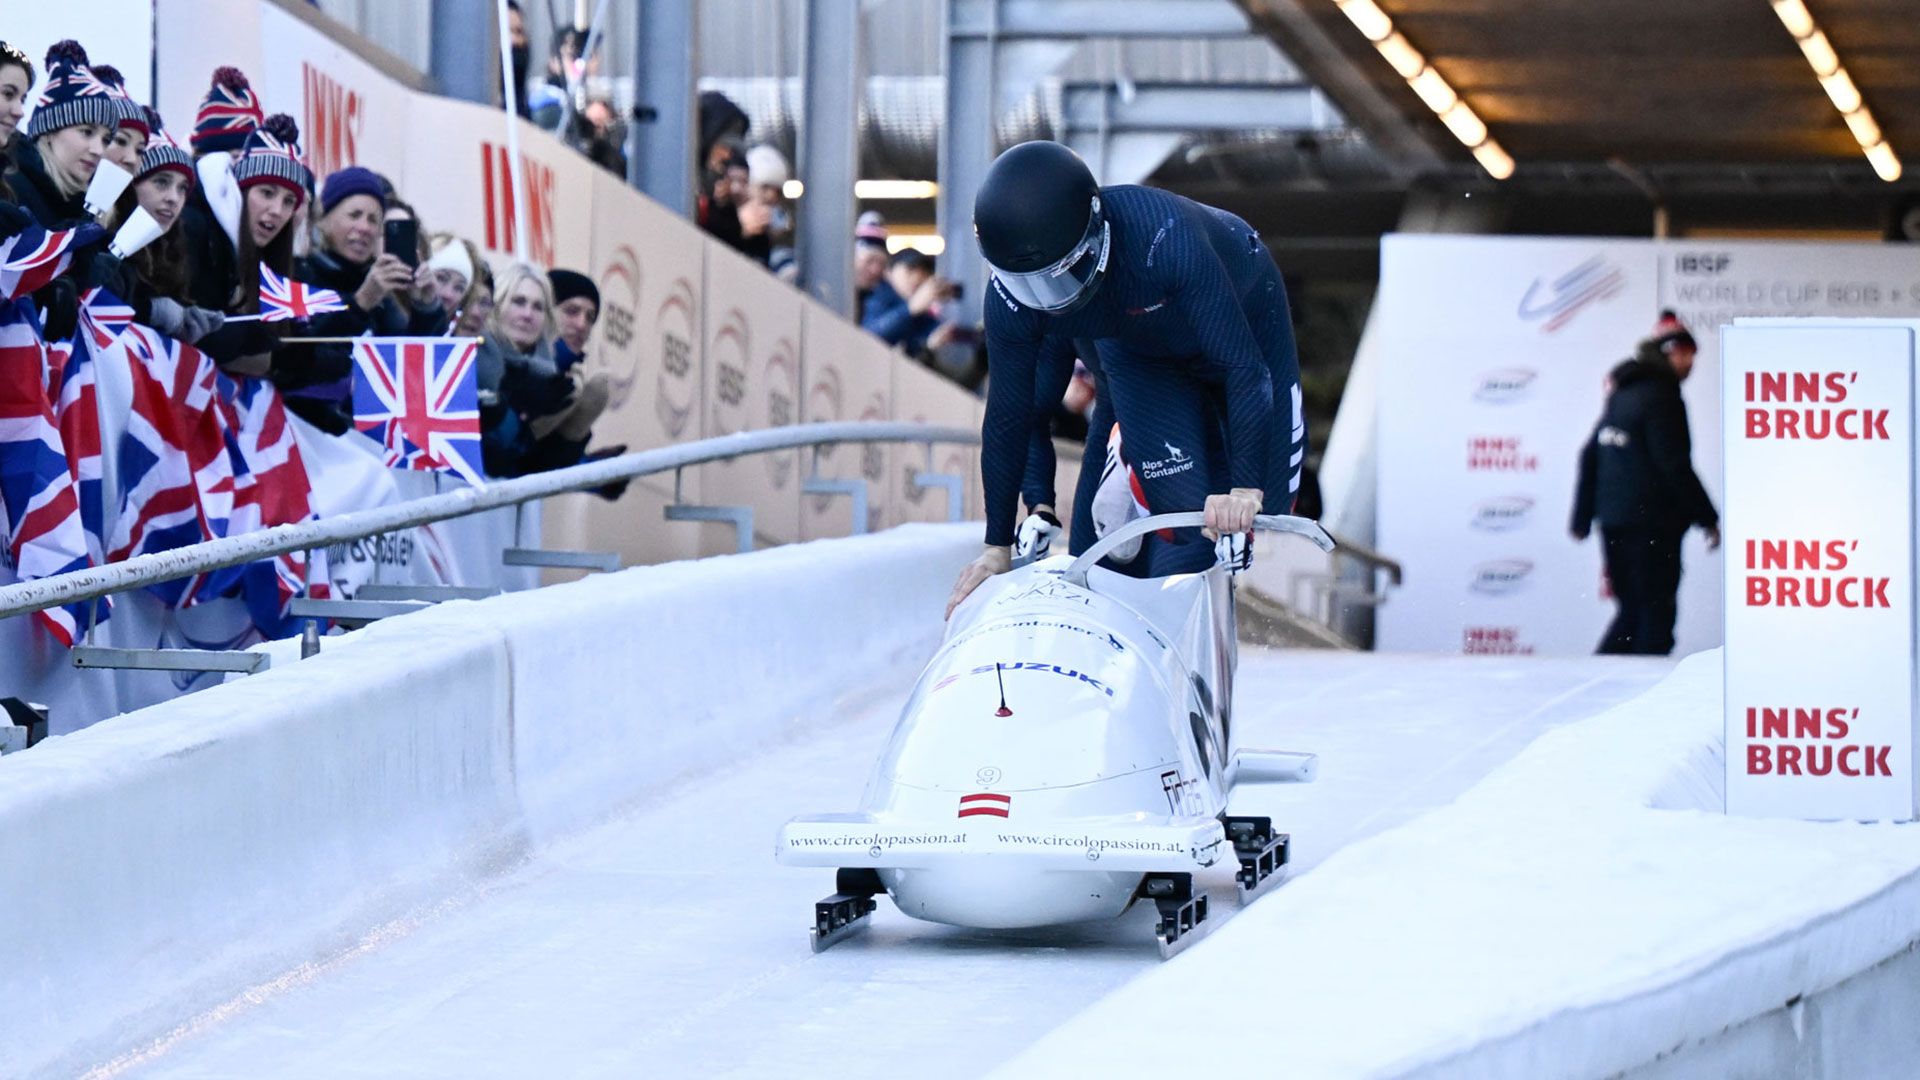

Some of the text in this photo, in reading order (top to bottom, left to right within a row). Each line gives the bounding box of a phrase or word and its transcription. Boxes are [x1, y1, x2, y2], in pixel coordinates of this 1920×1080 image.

[1674, 255, 1731, 274] IBSF
[1676, 285, 1763, 303] WORLD
[1769, 284, 1820, 303] CUP
[1745, 372, 1858, 403] INNS'
[1745, 409, 1890, 440] BRUCK
[1142, 461, 1163, 471] Alps
[1144, 461, 1194, 480] Container
[1746, 540, 1859, 571] INNS'
[1746, 576, 1891, 608] BRUCK
[970, 662, 1113, 697] SUZUKI
[1746, 708, 1860, 740] INNS'
[1747, 745, 1893, 777] BRUCK
[790, 833, 1181, 853] www.circolopassion.at www.circolopassion.at
